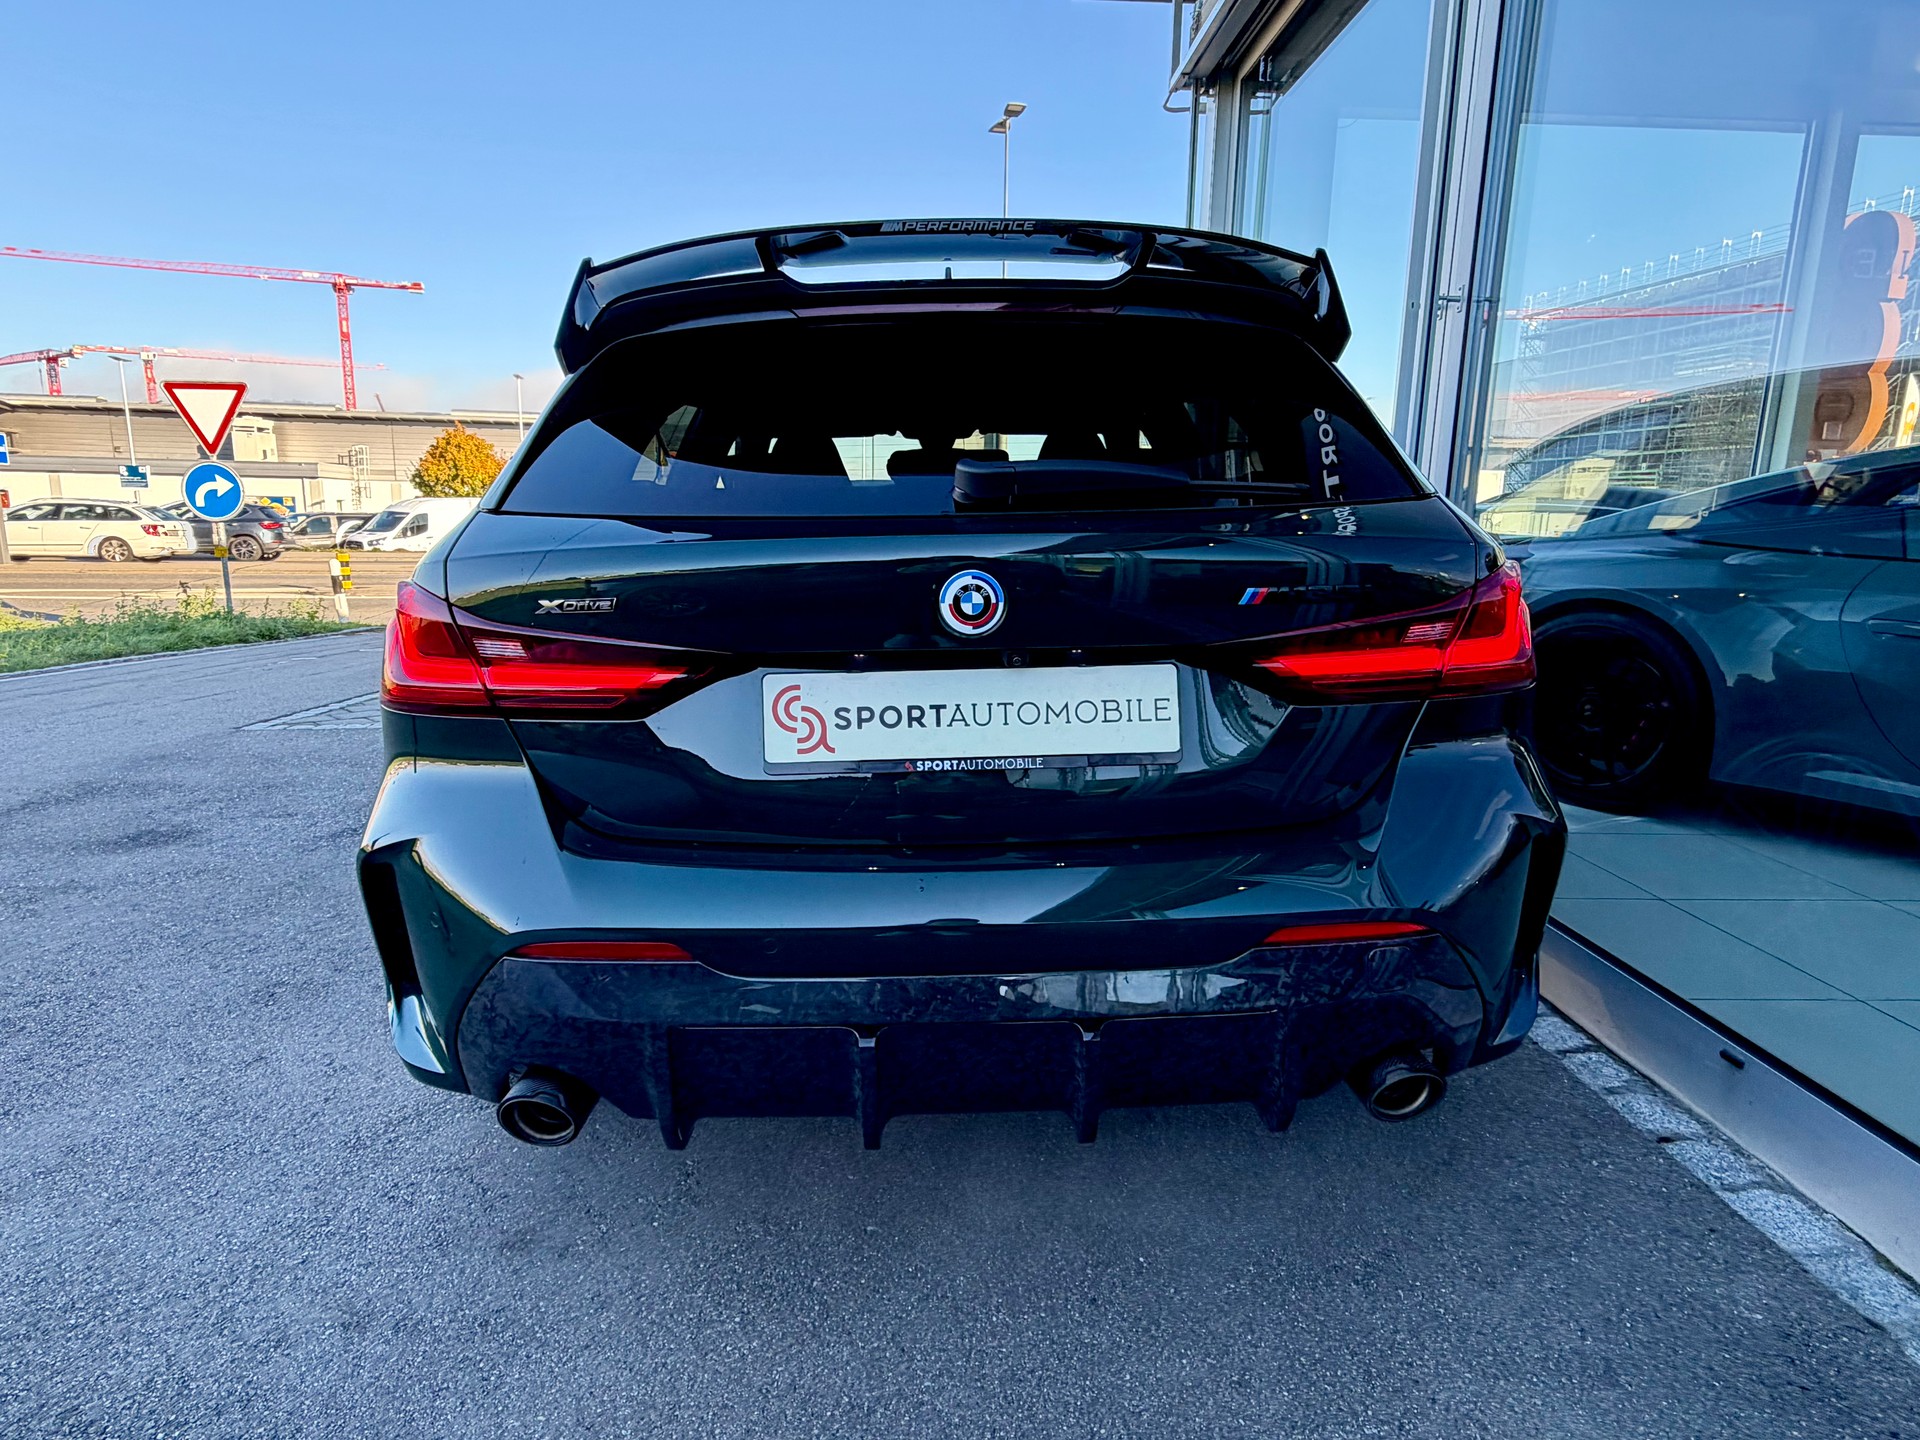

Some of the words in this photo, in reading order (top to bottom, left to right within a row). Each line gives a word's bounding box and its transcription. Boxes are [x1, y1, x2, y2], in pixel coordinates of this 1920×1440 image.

[904, 220, 1036, 232] PERFORMANCE
[956, 584, 989, 598] BMW
[834, 697, 1172, 731] SPORTAUTOMOBILE
[916, 757, 1044, 771] SPORTAUTOMOBILE
